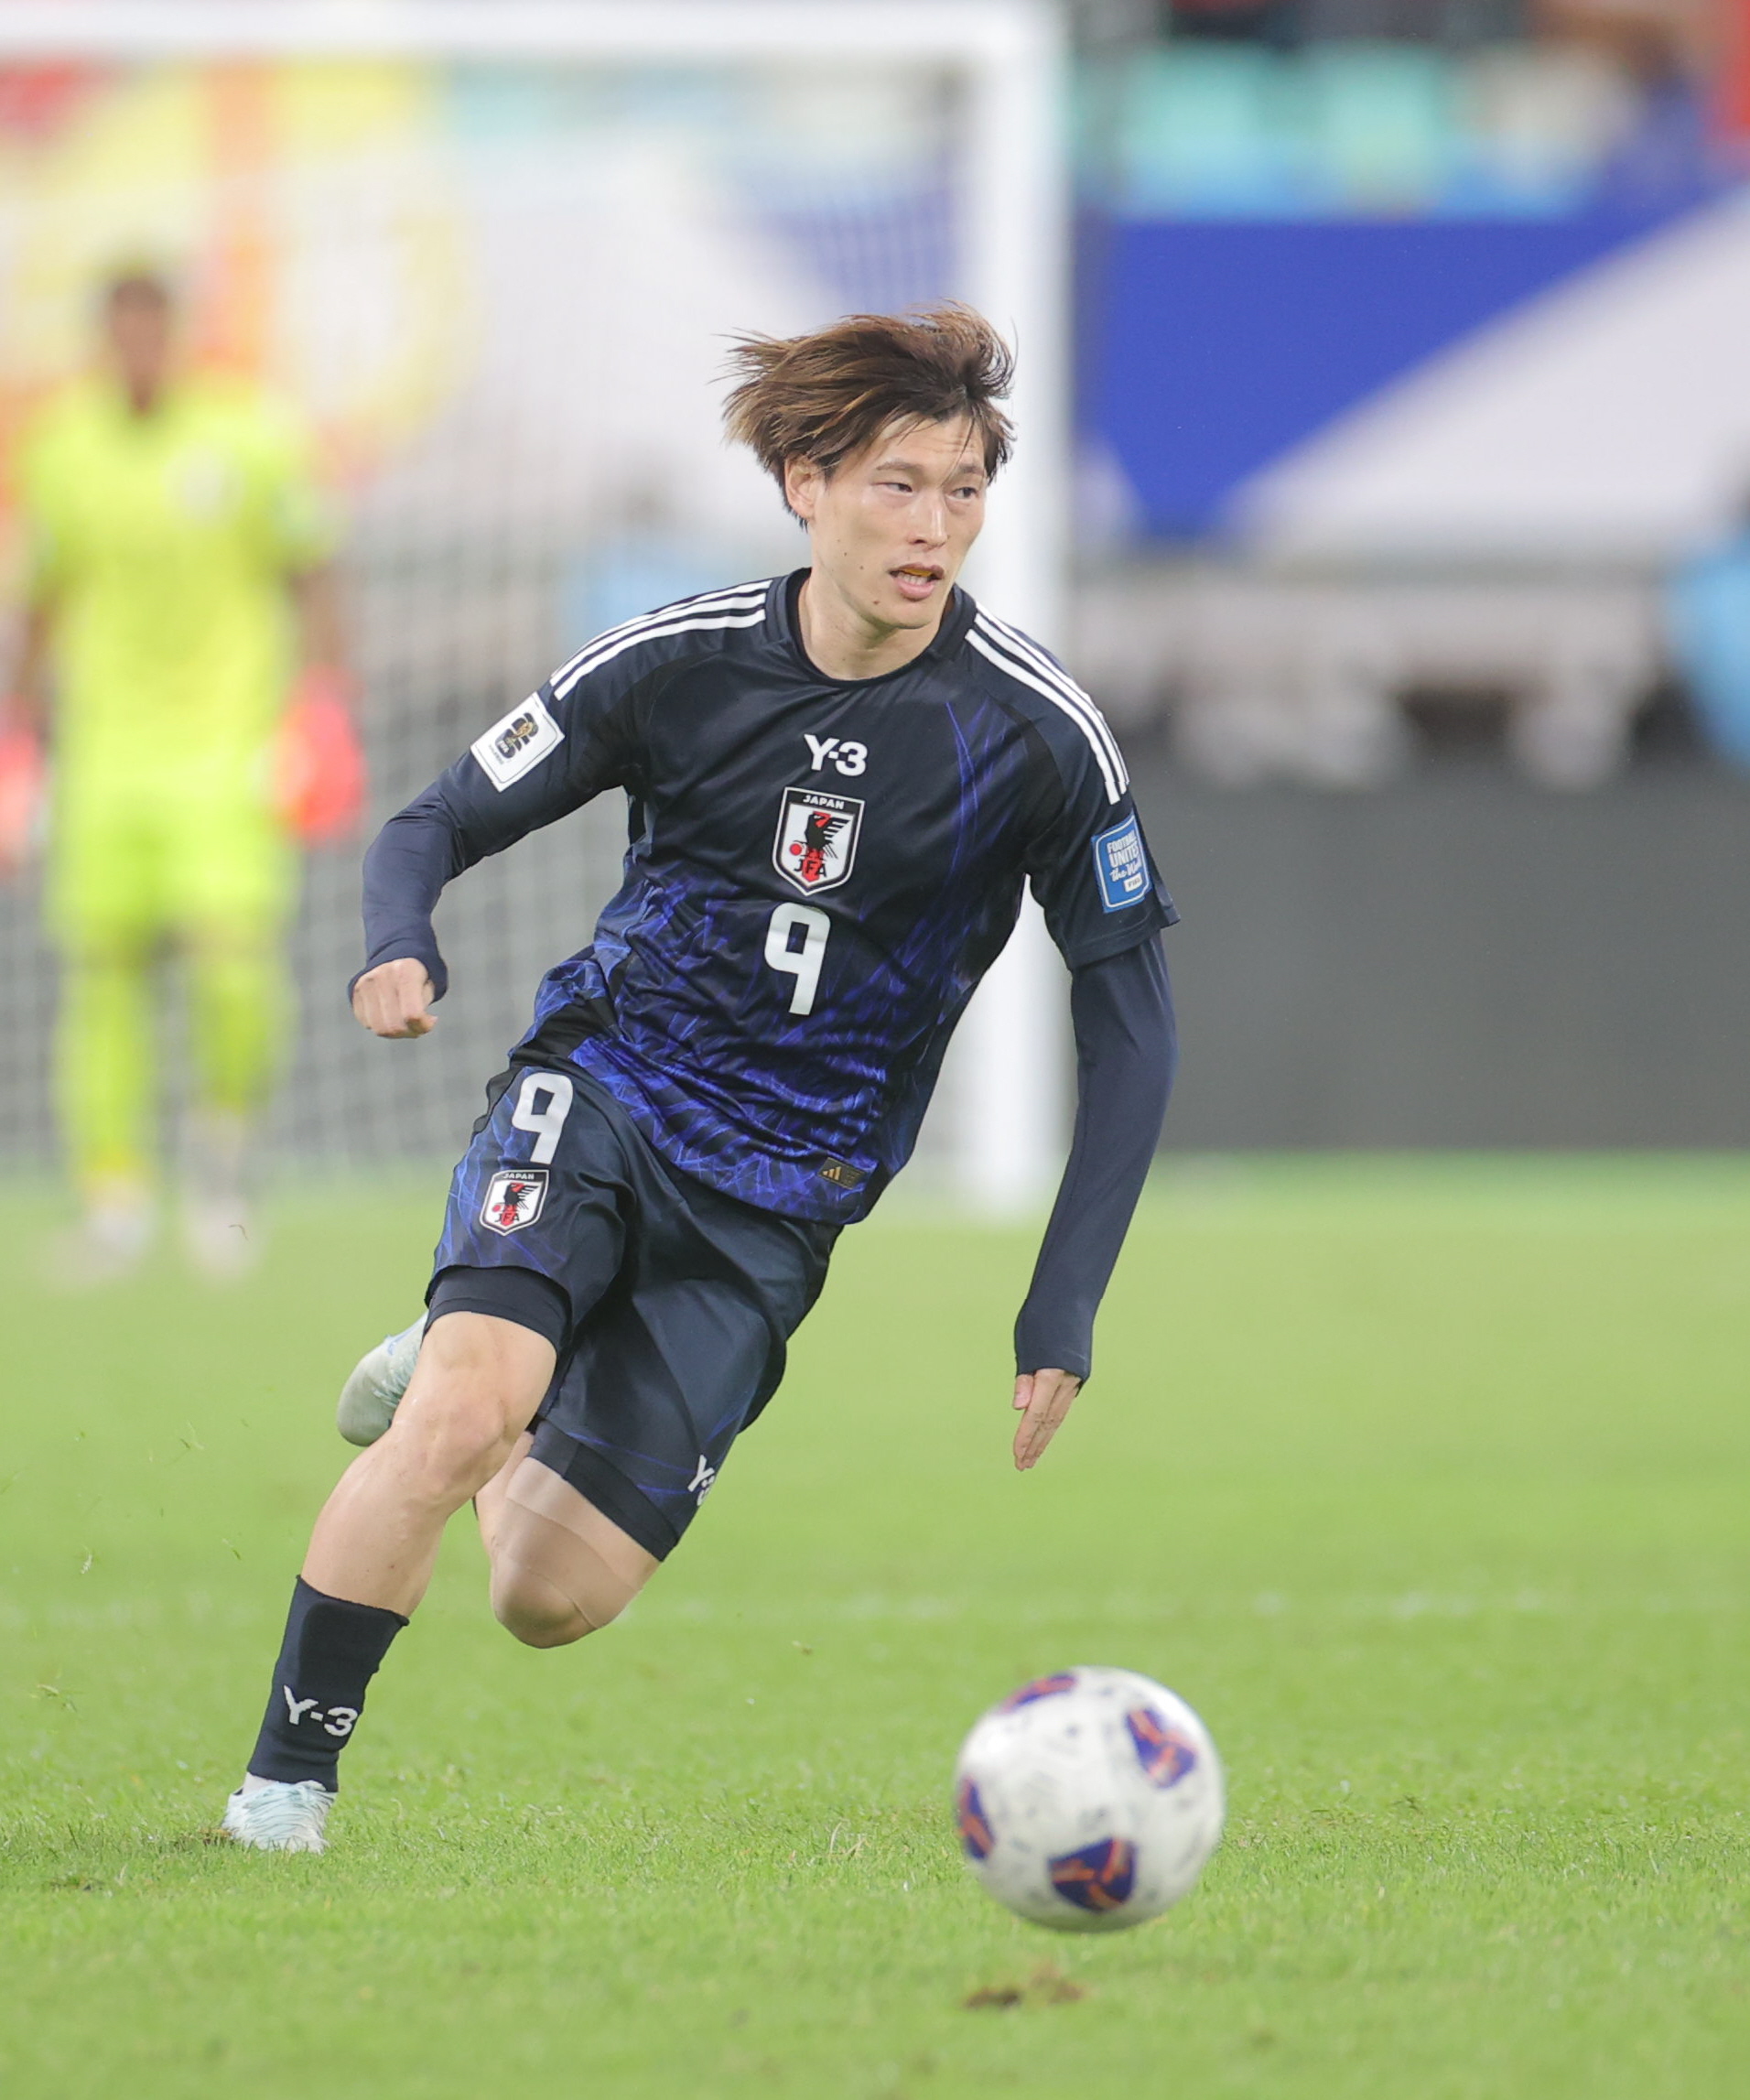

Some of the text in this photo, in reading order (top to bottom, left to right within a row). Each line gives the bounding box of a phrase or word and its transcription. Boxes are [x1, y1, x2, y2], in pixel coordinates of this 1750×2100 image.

[804, 733, 868, 776] Y-3
[803, 795, 844, 809] JAPAN
[794, 858, 826, 878] JFA
[764, 902, 831, 1016] 9
[512, 1072, 574, 1164] 9
[494, 1213, 520, 1223] JFA
[284, 1684, 358, 1737] Y-3
